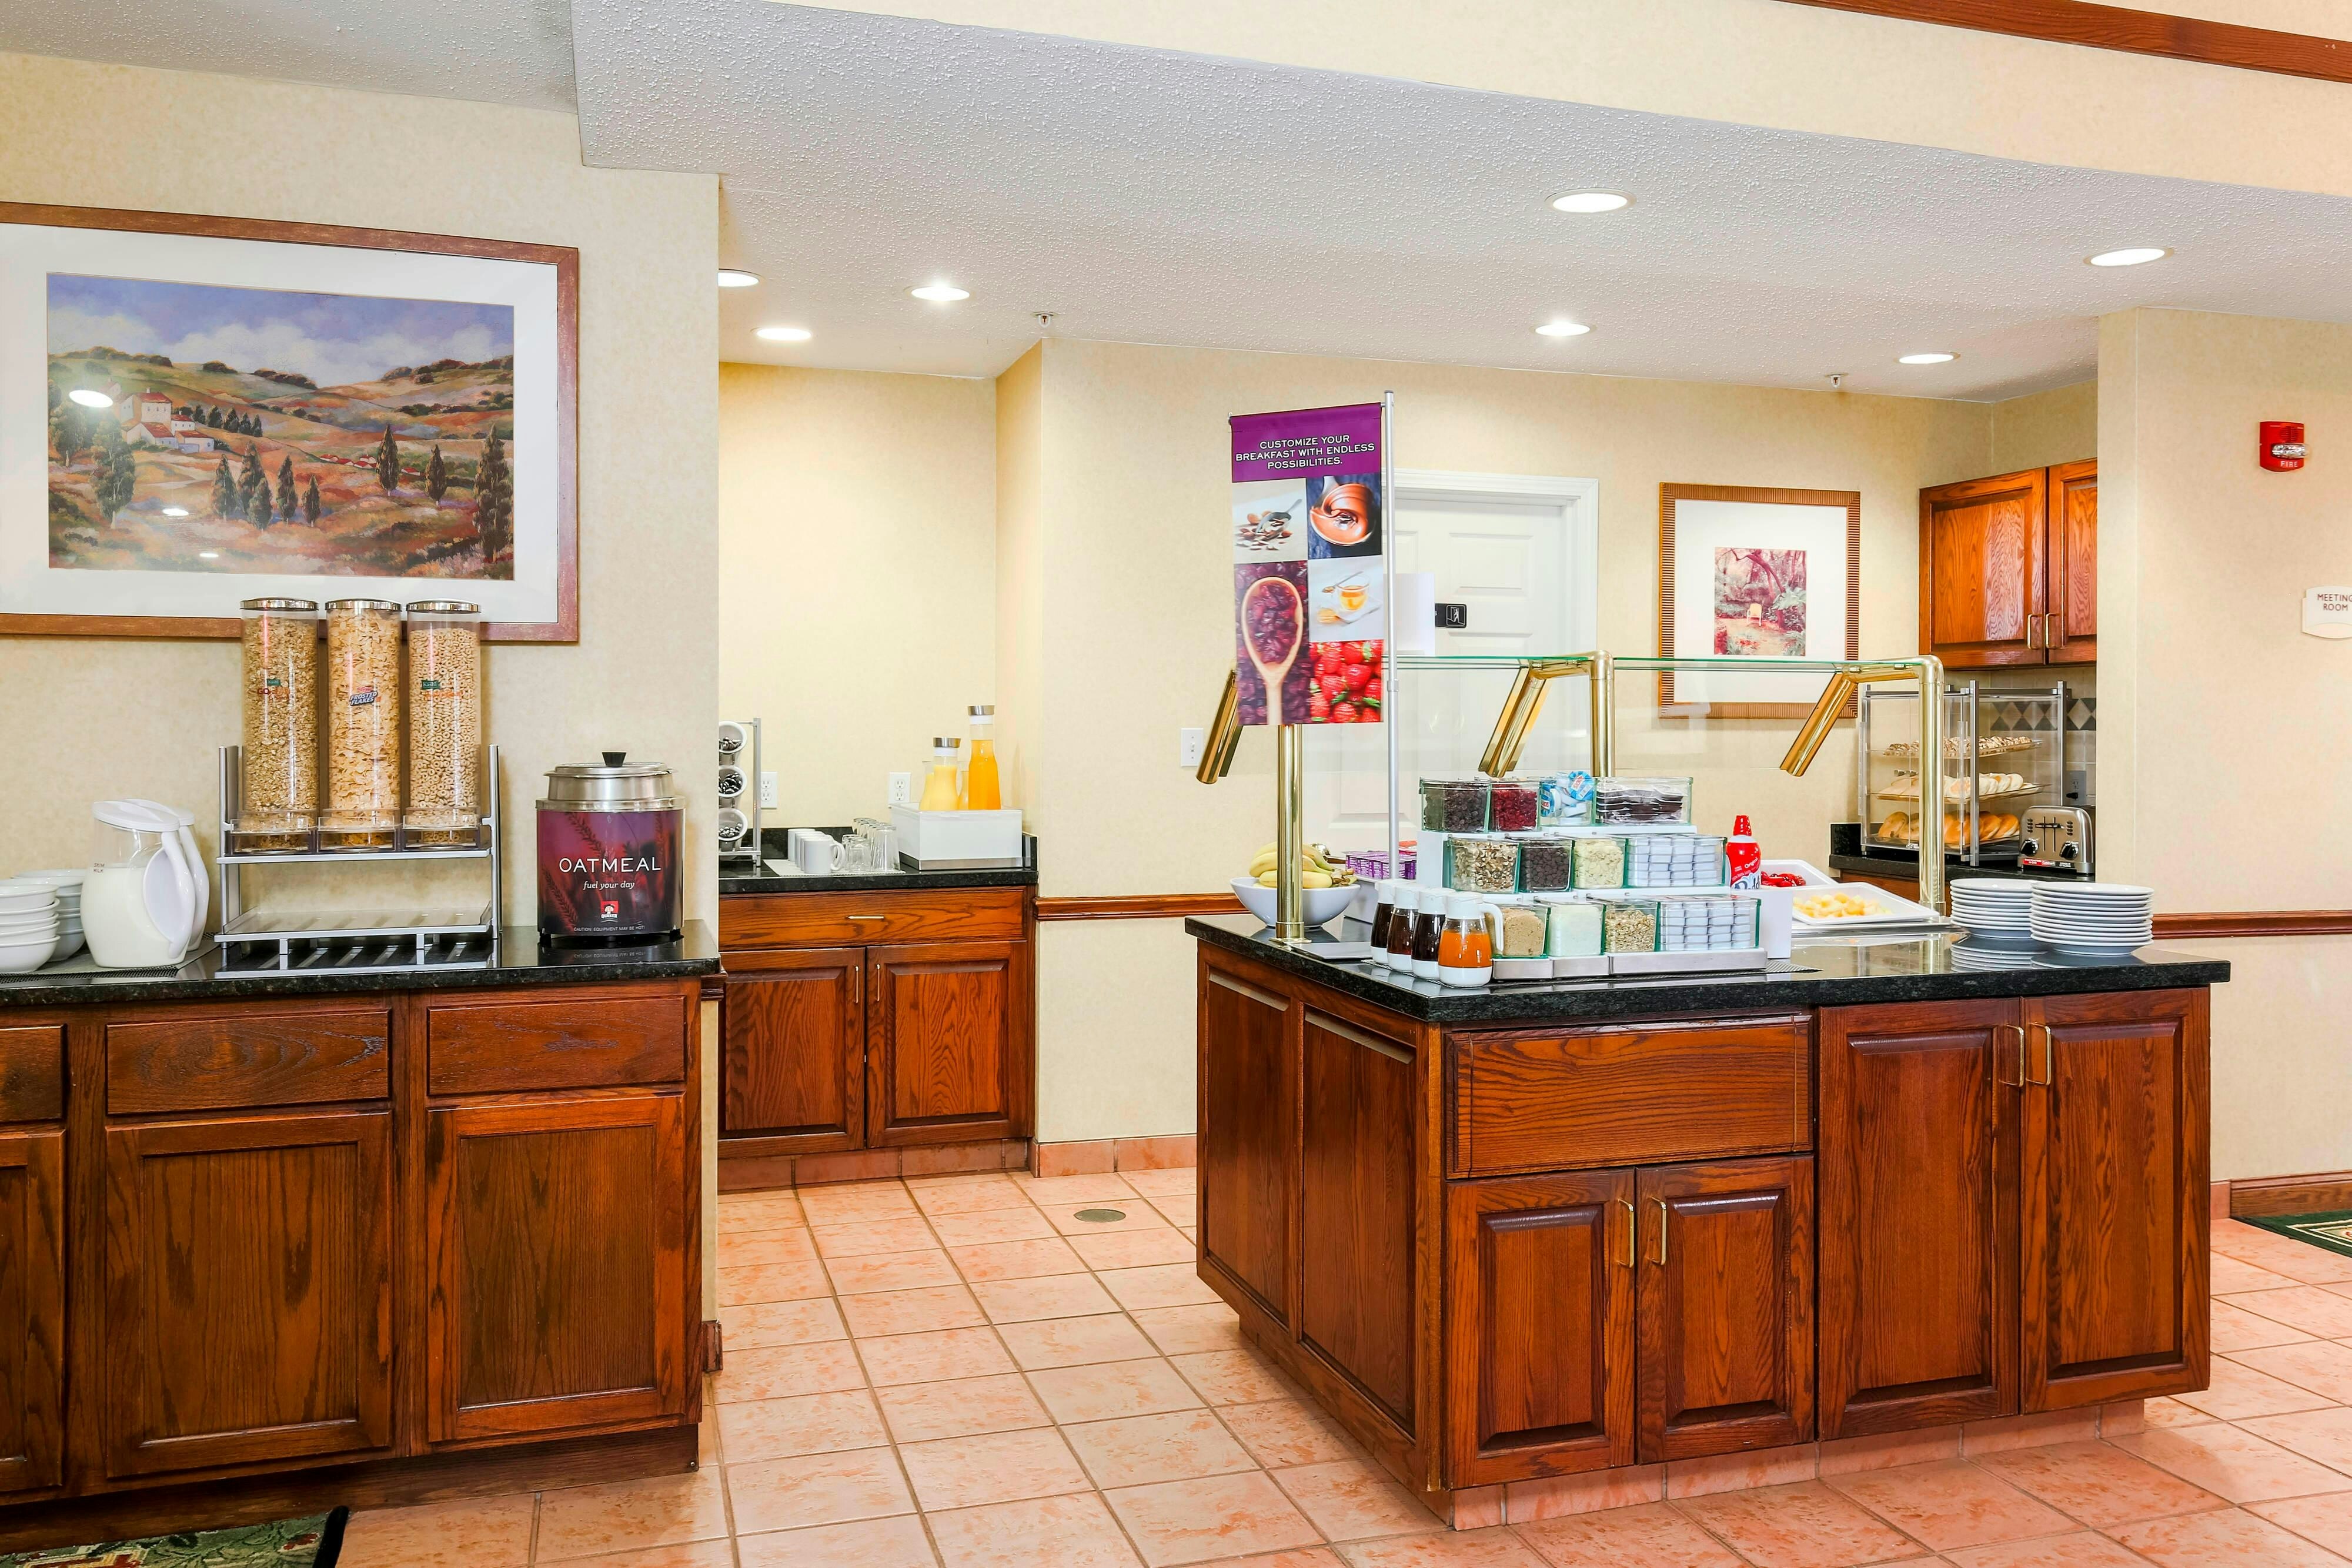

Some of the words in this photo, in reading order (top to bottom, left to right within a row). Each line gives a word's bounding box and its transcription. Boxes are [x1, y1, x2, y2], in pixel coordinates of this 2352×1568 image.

[1259, 437, 1318, 449] CUSTOMIZE
[1321, 435, 1350, 444] YOUR
[1235, 449, 1295, 462] BREAKFAST
[1298, 447, 1323, 457] WITH
[1327, 443, 1375, 454] ENDLESS
[1267, 456, 1342, 470] POSSIBILITIES.
[2323, 603, 2348, 611] ROOM
[350, 691, 377, 701] FROSTED
[351, 697, 374, 706] FLAKES
[559, 857, 662, 873] OATMEAL
[1744, 857, 1758, 868] Original
[583, 881, 598, 890] fuel
[620, 881, 635, 890] day
